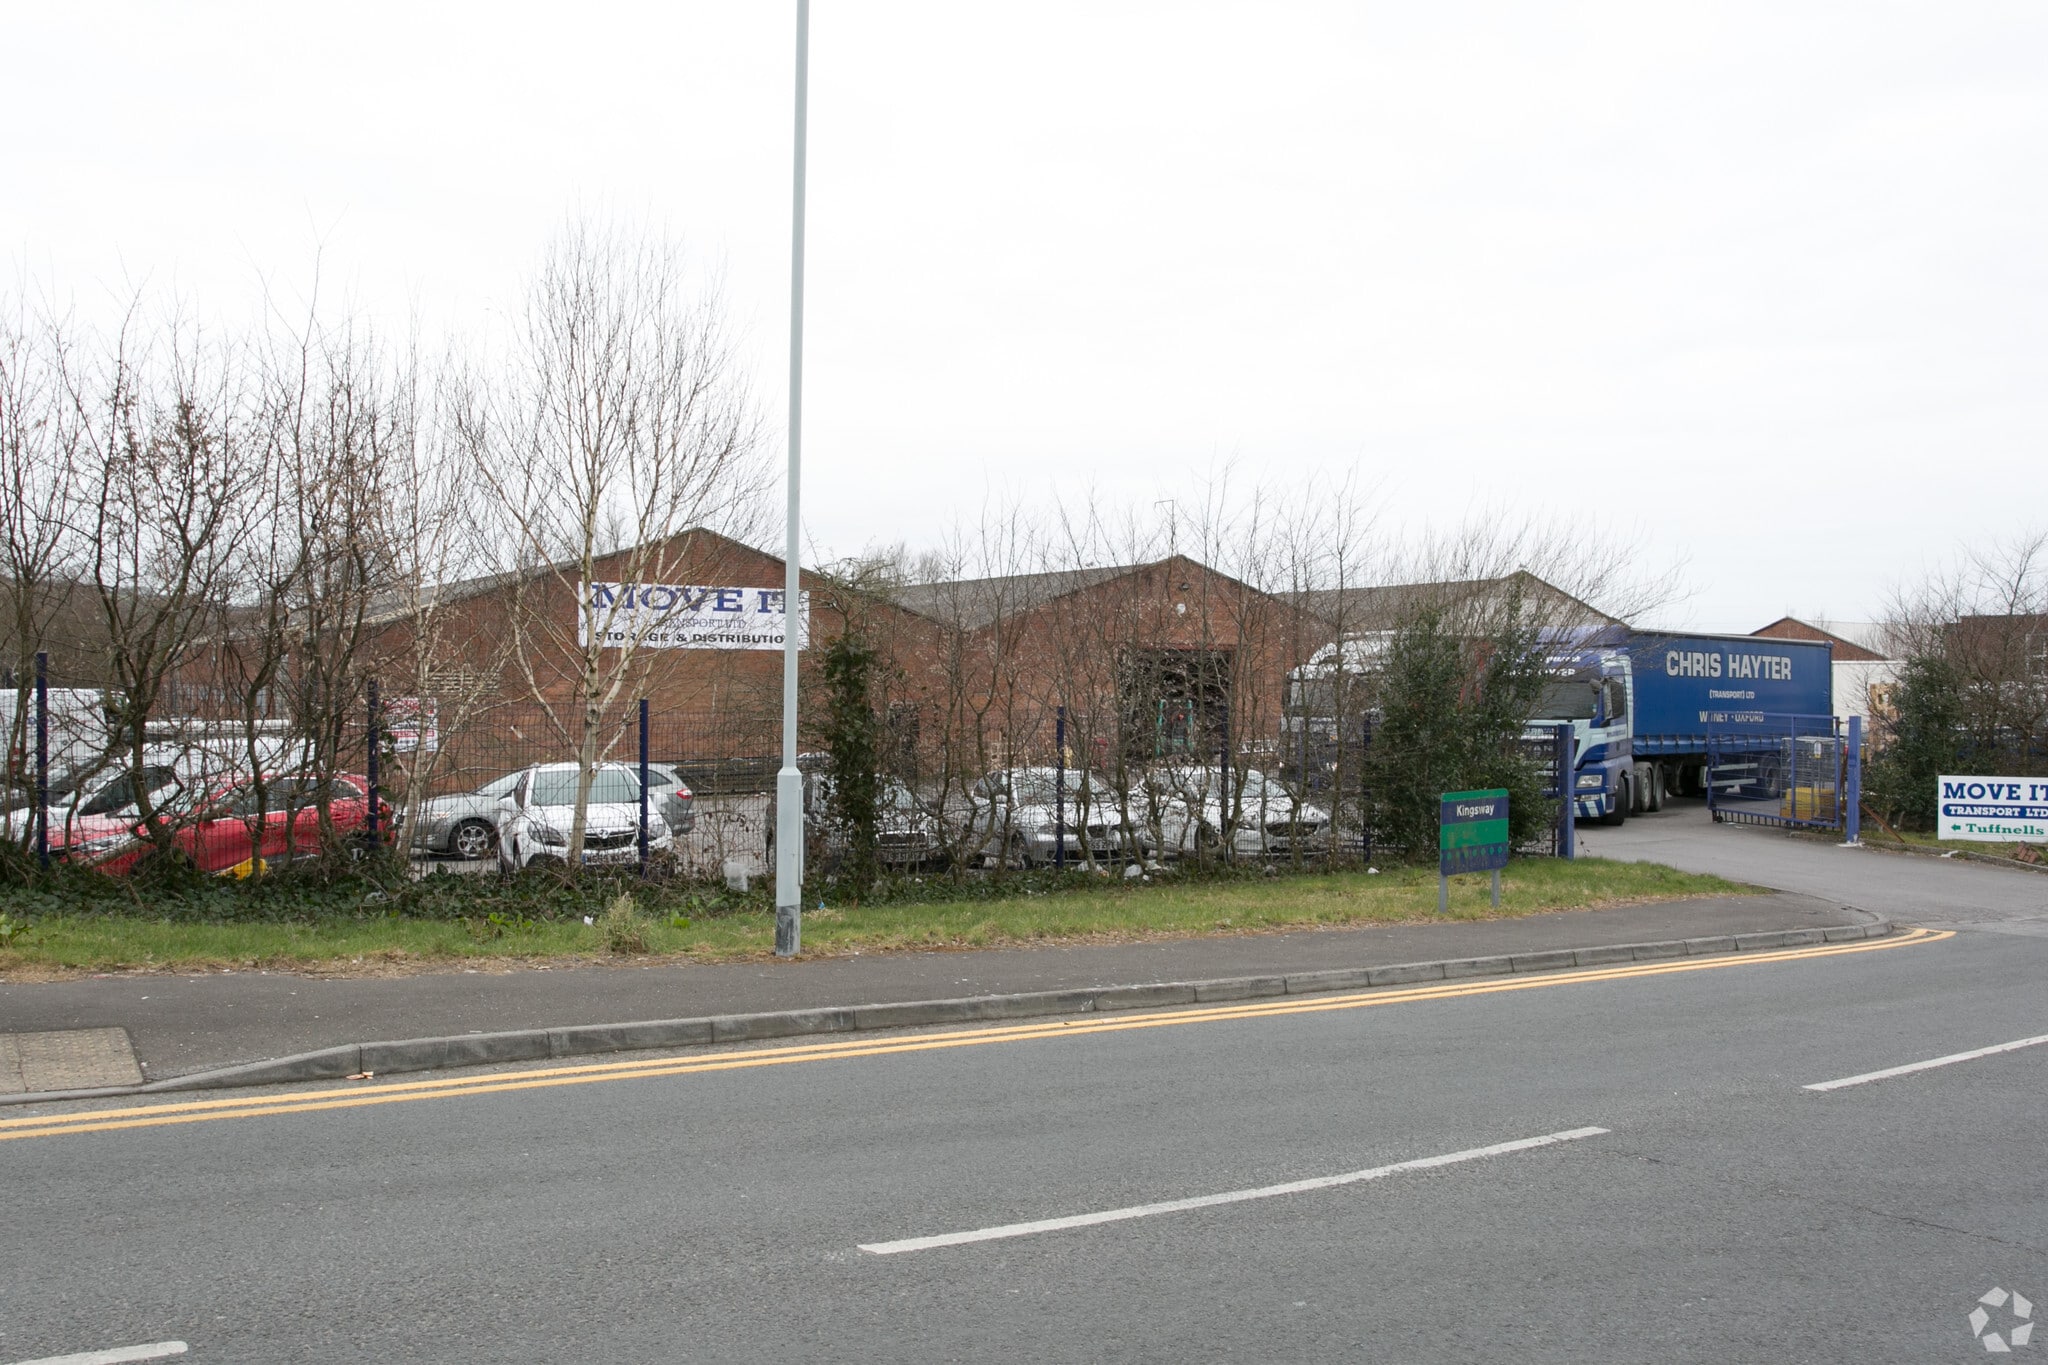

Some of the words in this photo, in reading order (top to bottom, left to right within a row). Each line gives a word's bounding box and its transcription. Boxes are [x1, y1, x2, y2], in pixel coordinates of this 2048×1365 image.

[591, 585, 743, 613] MOVE
[653, 618, 722, 628] TANSPORT
[595, 631, 669, 642] STORGE
[676, 633, 688, 642] &
[693, 633, 785, 644] DISTRIBUTIO
[1666, 650, 1722, 678] CHRIS
[1728, 654, 1792, 680] HAYTER
[1746, 691, 1755, 699] LTD
[1699, 711, 1728, 722] WTNEY
[1943, 783, 2021, 801] MOVE
[1456, 804, 1495, 818] Kingsway
[1949, 806, 2021, 817] TRANSPORT
[2025, 808, 2048, 818] LTD
[1965, 823, 2045, 836] Tuffnells
